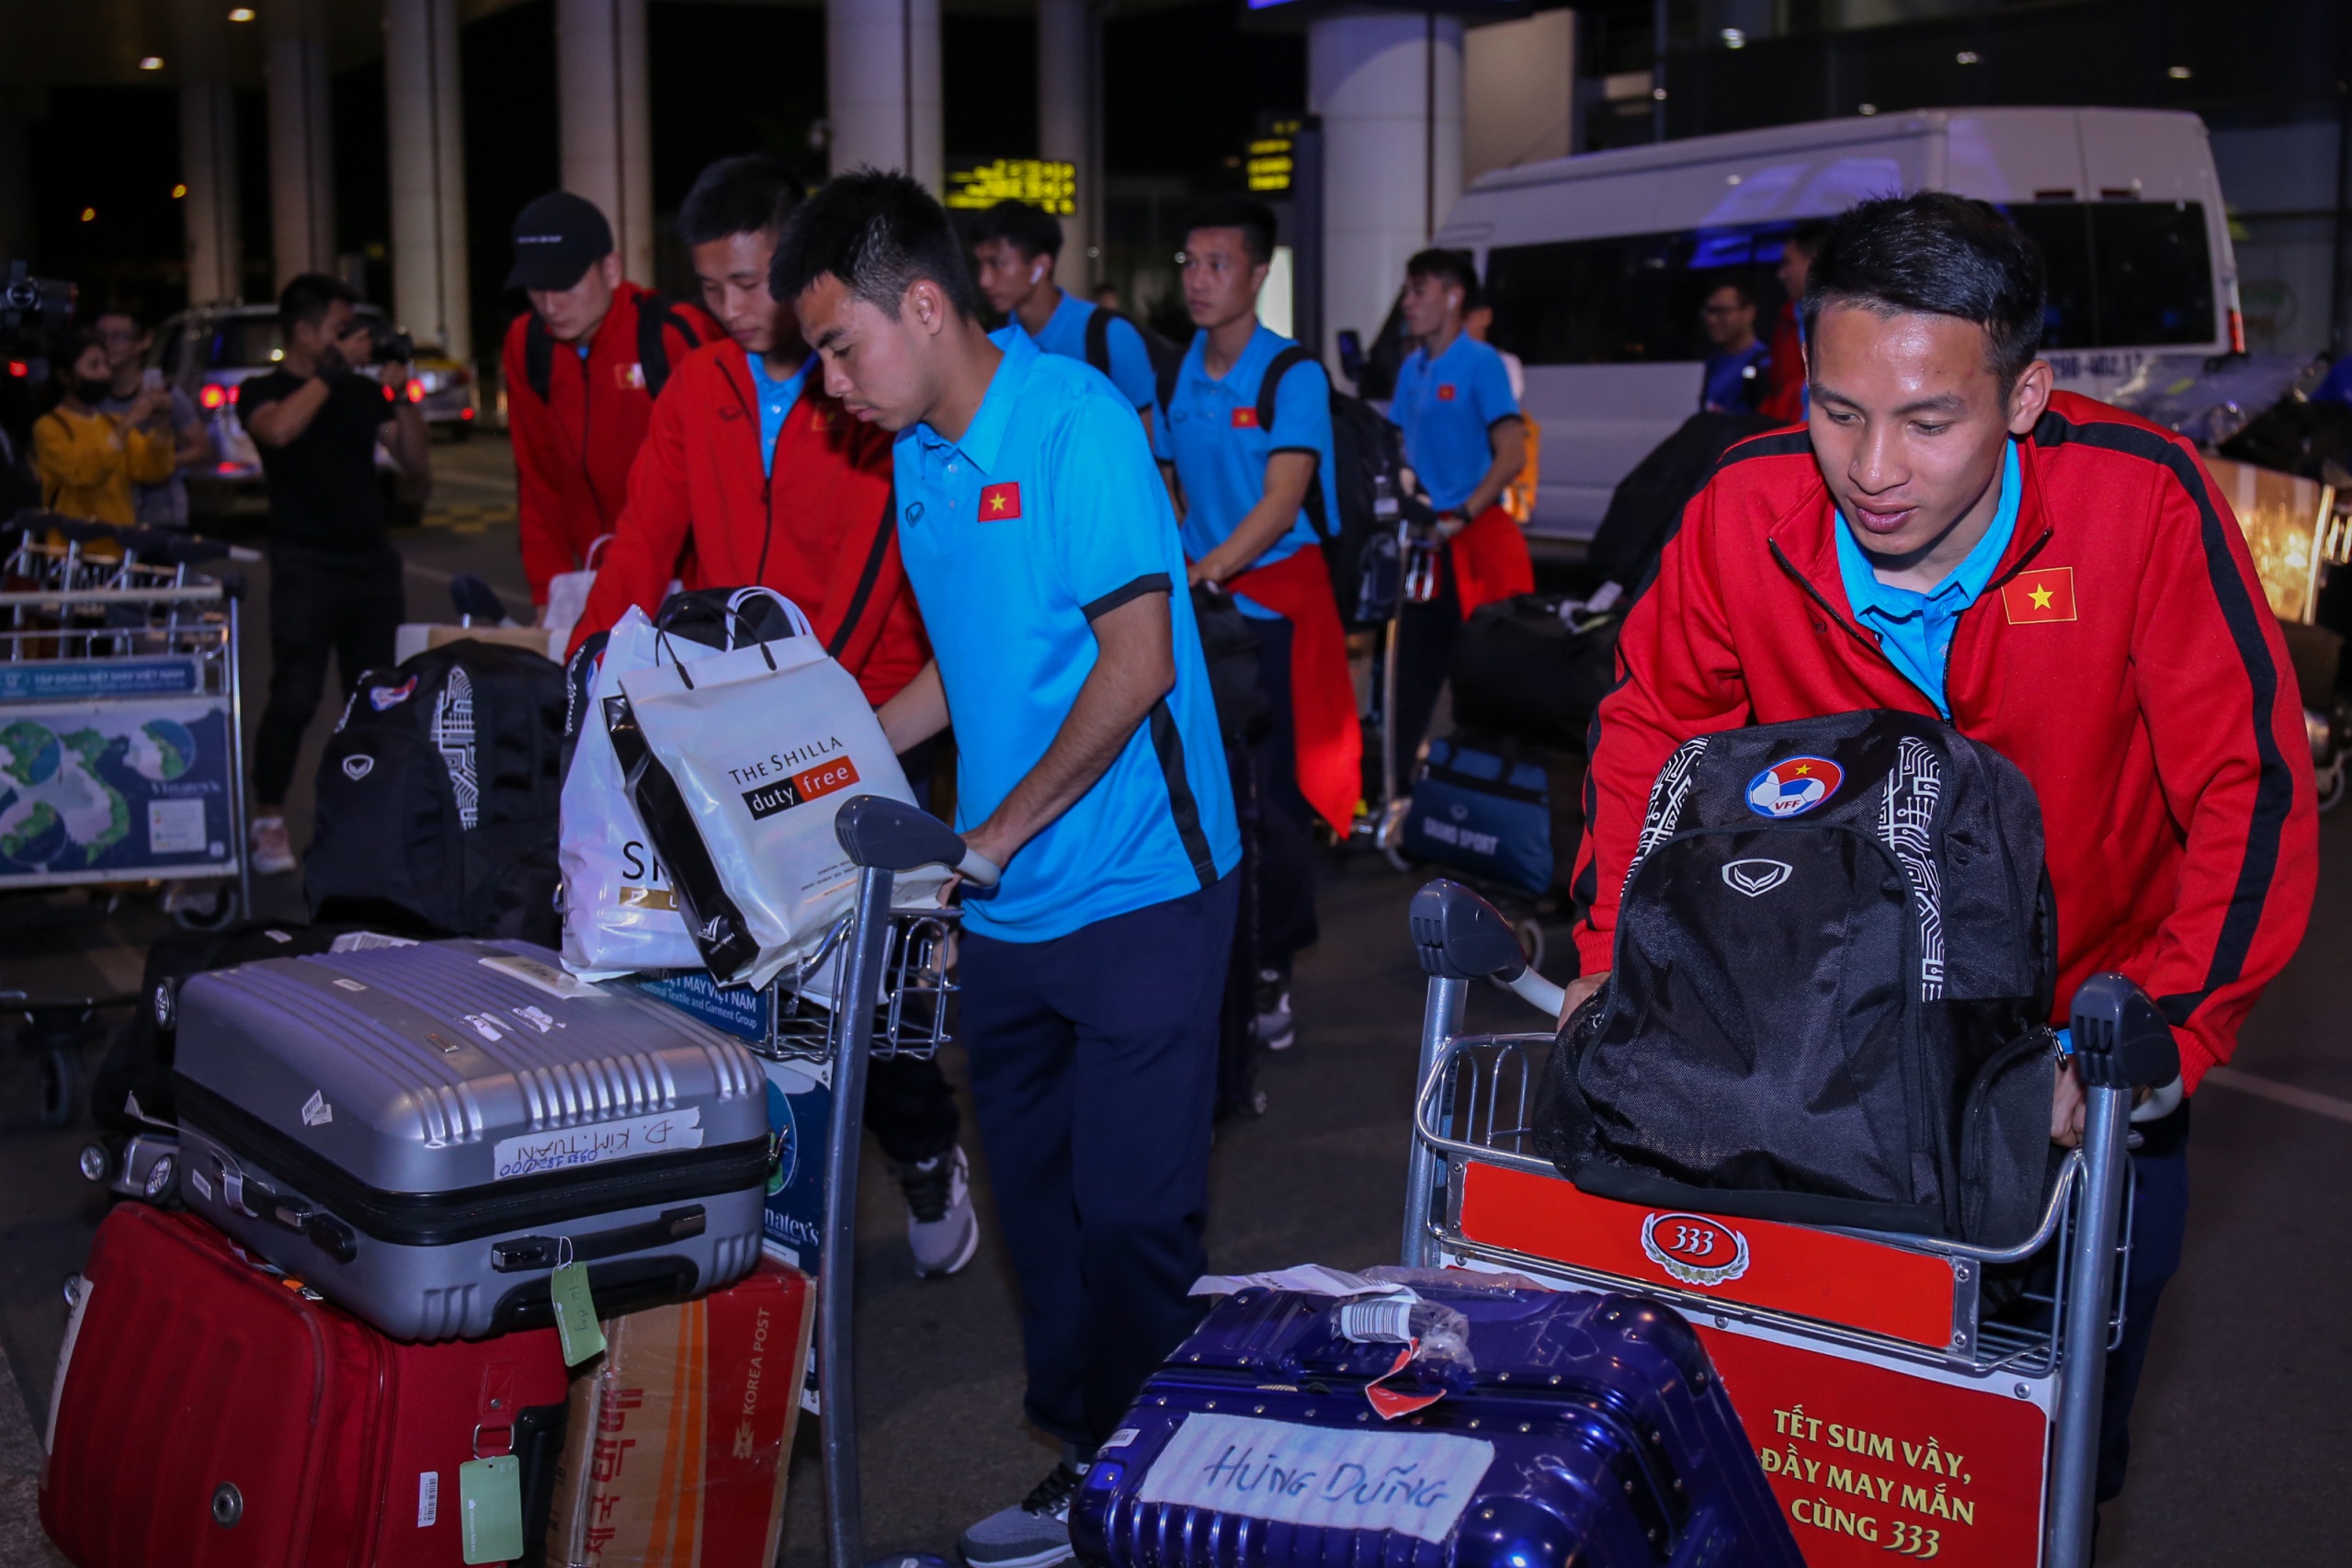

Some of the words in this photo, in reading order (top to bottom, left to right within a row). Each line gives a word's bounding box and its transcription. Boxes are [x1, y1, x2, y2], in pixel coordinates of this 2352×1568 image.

[728, 762, 768, 785] THE
[770, 736, 844, 771] SHILLA
[752, 787, 794, 812] duty
[802, 767, 849, 793] free
[1775, 800, 1801, 811] VFF
[668, 989, 690, 1006] Textile
[691, 998, 704, 1009] and
[705, 1001, 734, 1020] Garment
[735, 1012, 757, 1029] Group
[684, 976, 708, 994] MAY
[731, 992, 756, 1013] NAM
[1668, 1225, 1714, 1256] 333
[743, 1357, 763, 1415] KOREA
[753, 1307, 770, 1352] POST
[1773, 1403, 1823, 1442] TẾT
[1826, 1424, 1894, 1462] SUM
[1760, 1442, 1821, 1484] ĐẦY
[1826, 1464, 1895, 1504] MAY
[1900, 1483, 1975, 1526] MẮN
[1790, 1497, 1879, 1542] CÙNG
[1882, 1520, 1941, 1561] 333
